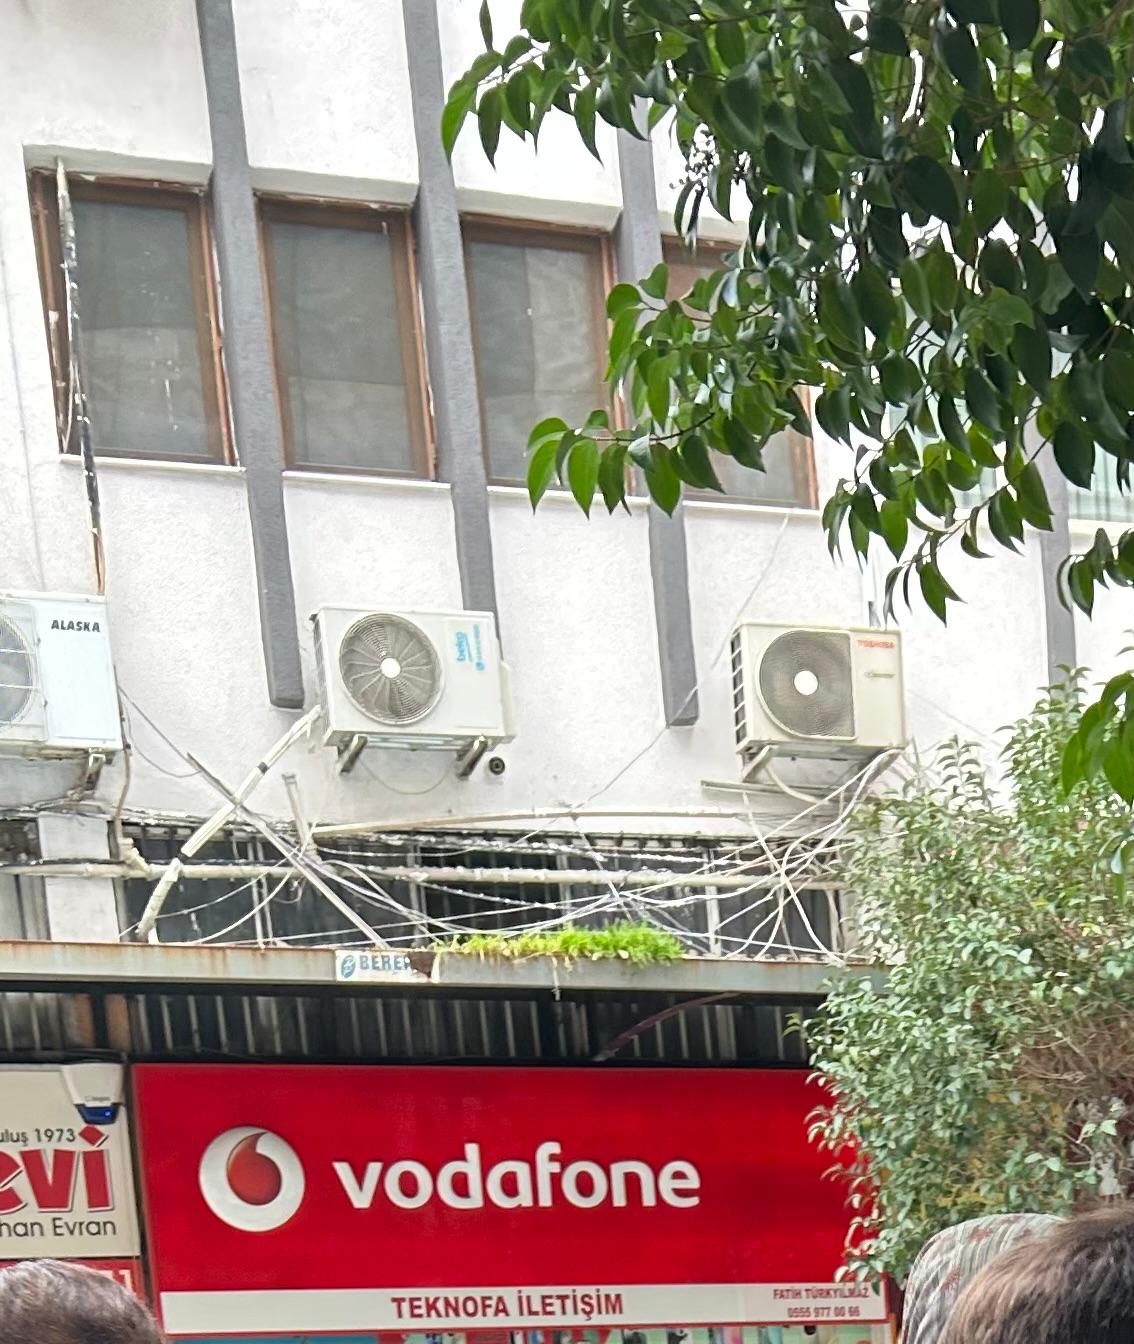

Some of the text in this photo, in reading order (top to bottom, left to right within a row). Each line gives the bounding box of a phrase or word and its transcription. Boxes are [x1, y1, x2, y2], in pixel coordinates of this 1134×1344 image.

[51, 619, 101, 632] ALASKA
[34, 1127, 76, 1143] 1973
[332, 1141, 701, 1209] vodafone
[52, 1216, 117, 1238] Evran
[391, 1288, 624, 1321] TEKNOFA İLETİŞİM
